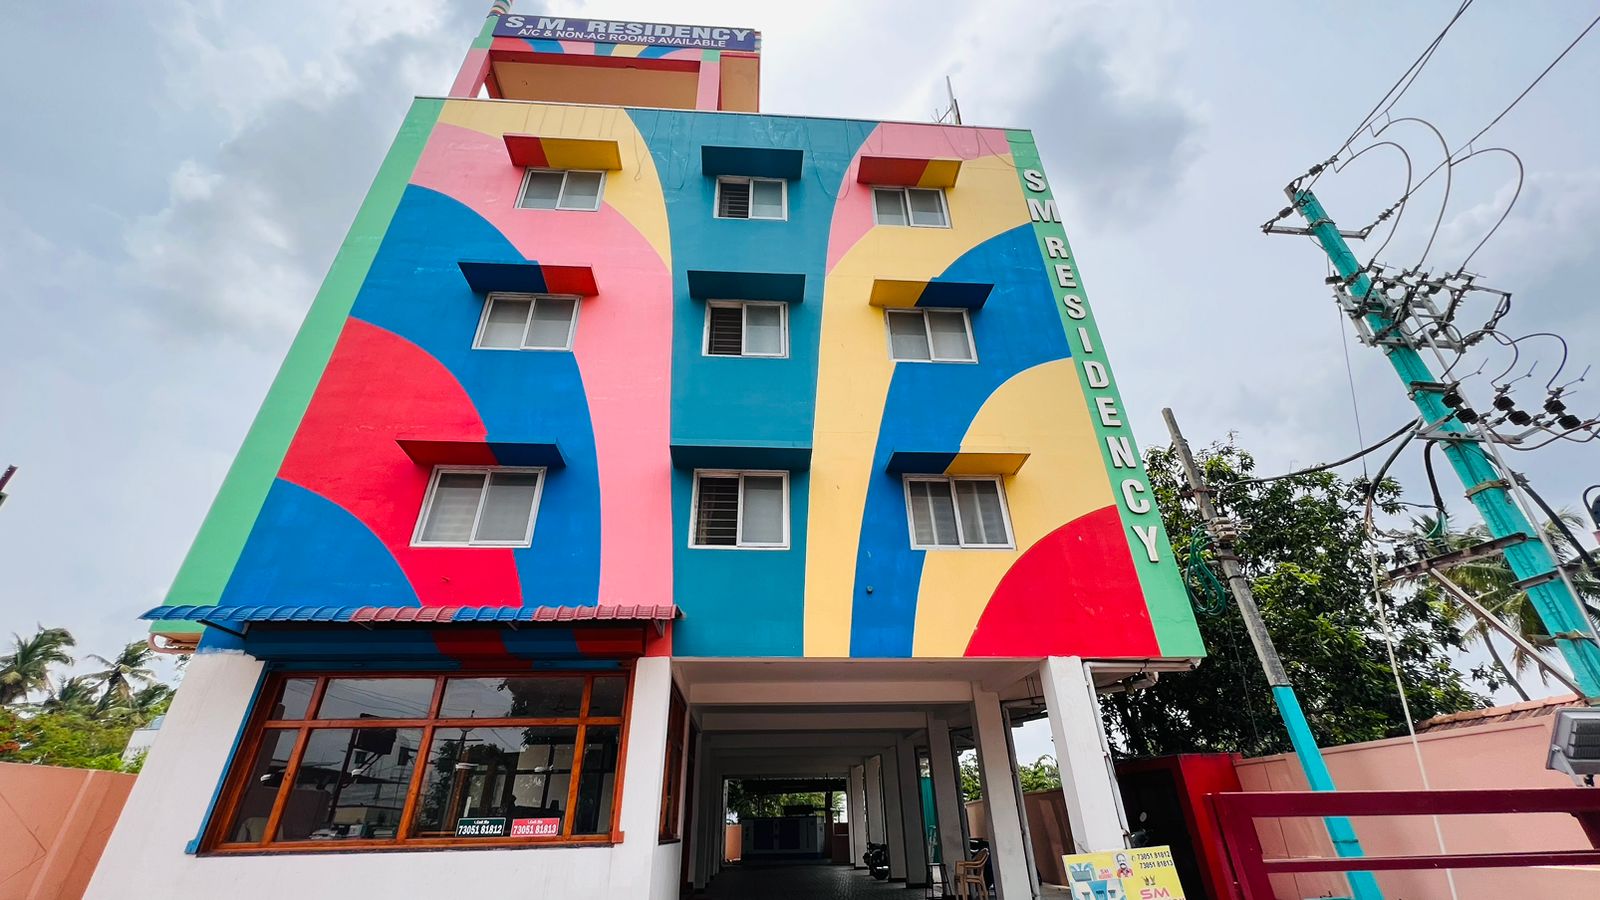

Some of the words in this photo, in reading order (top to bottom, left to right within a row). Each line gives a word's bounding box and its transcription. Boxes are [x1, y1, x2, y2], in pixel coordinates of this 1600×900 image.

[505, 16, 574, 31] S.M.
[587, 21, 751, 42] RESIDENCY
[518, 28, 541, 36] A/C
[543, 29, 553, 37] &
[556, 30, 605, 40] NON-AC
[609, 34, 656, 43] ROOMS
[658, 36, 726, 48] AVAILABLE
[1044, 235, 1159, 562] RESIDENCY
[458, 825, 480, 835] 73051
[480, 824, 503, 834] 81812
[513, 825, 534, 835] 73051
[535, 824, 557, 834] 81813
[1140, 887, 1170, 900] SM
